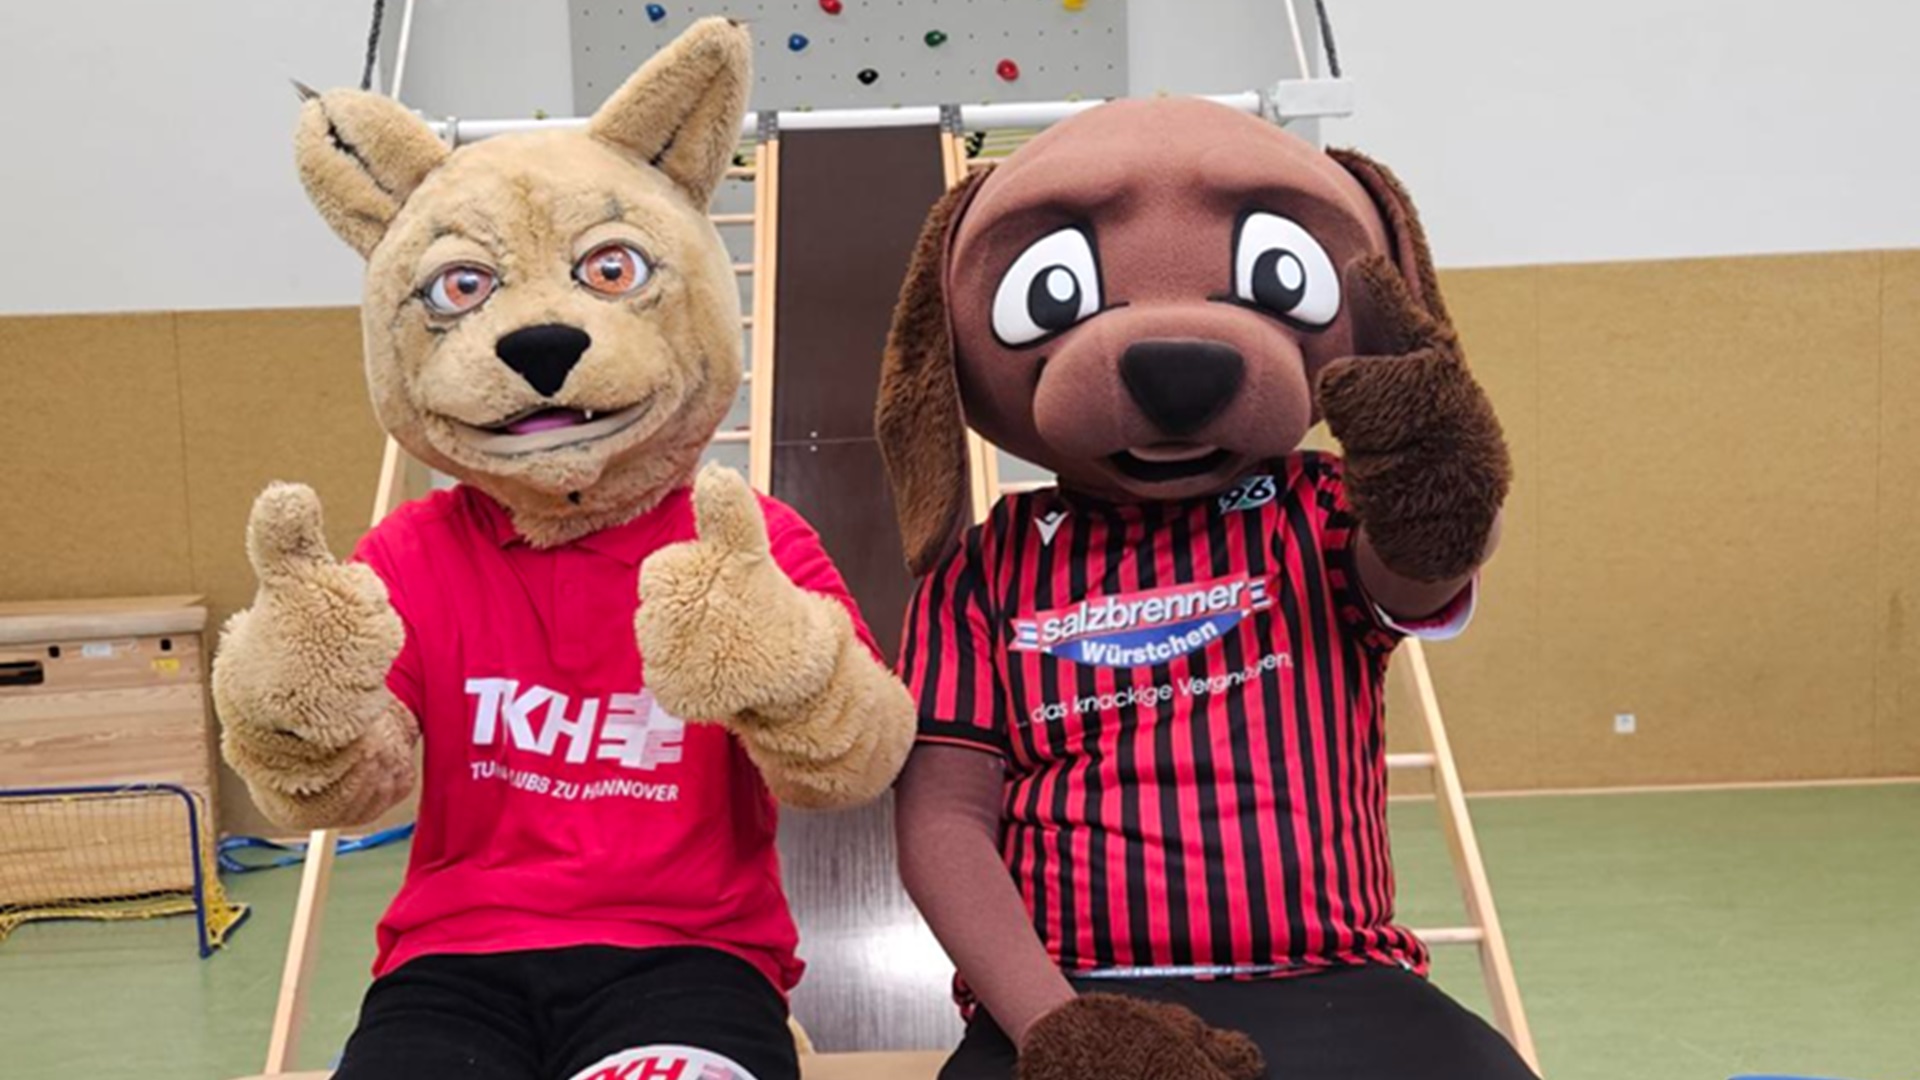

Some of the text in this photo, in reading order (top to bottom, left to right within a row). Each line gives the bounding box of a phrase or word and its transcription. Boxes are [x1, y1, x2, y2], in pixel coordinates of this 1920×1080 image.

[1219, 476, 1275, 512] 96
[1042, 581, 1245, 642] salzbrenner
[1081, 620, 1218, 665] Würstchen
[465, 678, 600, 763] TKH
[1032, 702, 1068, 723] das
[1073, 684, 1173, 715] knackige
[551, 780, 580, 800] ZU
